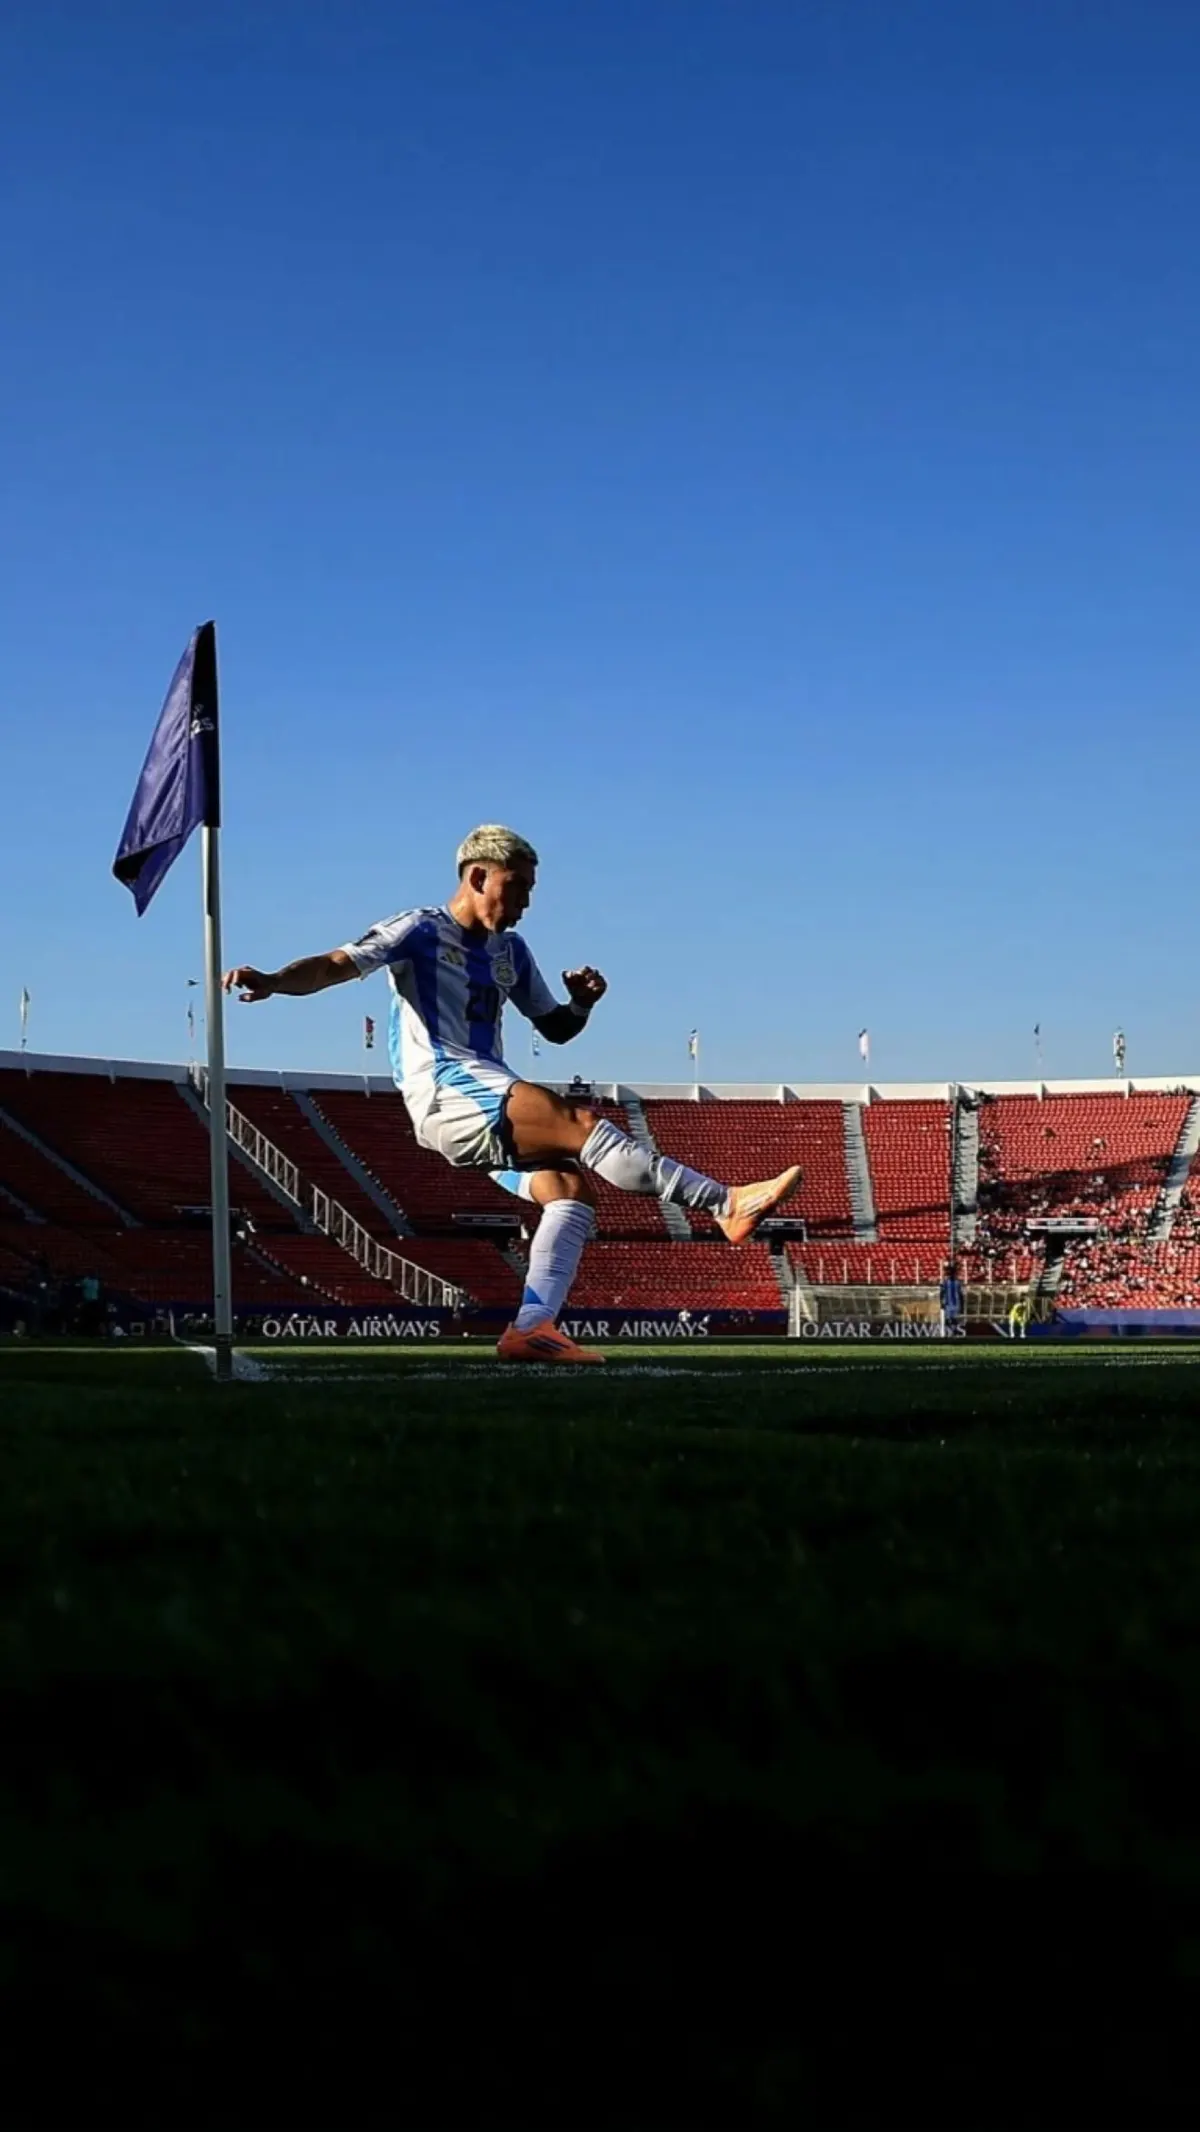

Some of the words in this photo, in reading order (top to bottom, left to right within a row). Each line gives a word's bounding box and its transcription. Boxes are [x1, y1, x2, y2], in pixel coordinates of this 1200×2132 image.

[465, 983, 499, 1022] 20
[262, 1319, 338, 1338] QATAR
[346, 1319, 441, 1338] AIRWAYS
[557, 1319, 610, 1338] ATAR
[618, 1319, 709, 1338] AIRWAYS
[801, 1321, 872, 1339] QATAR
